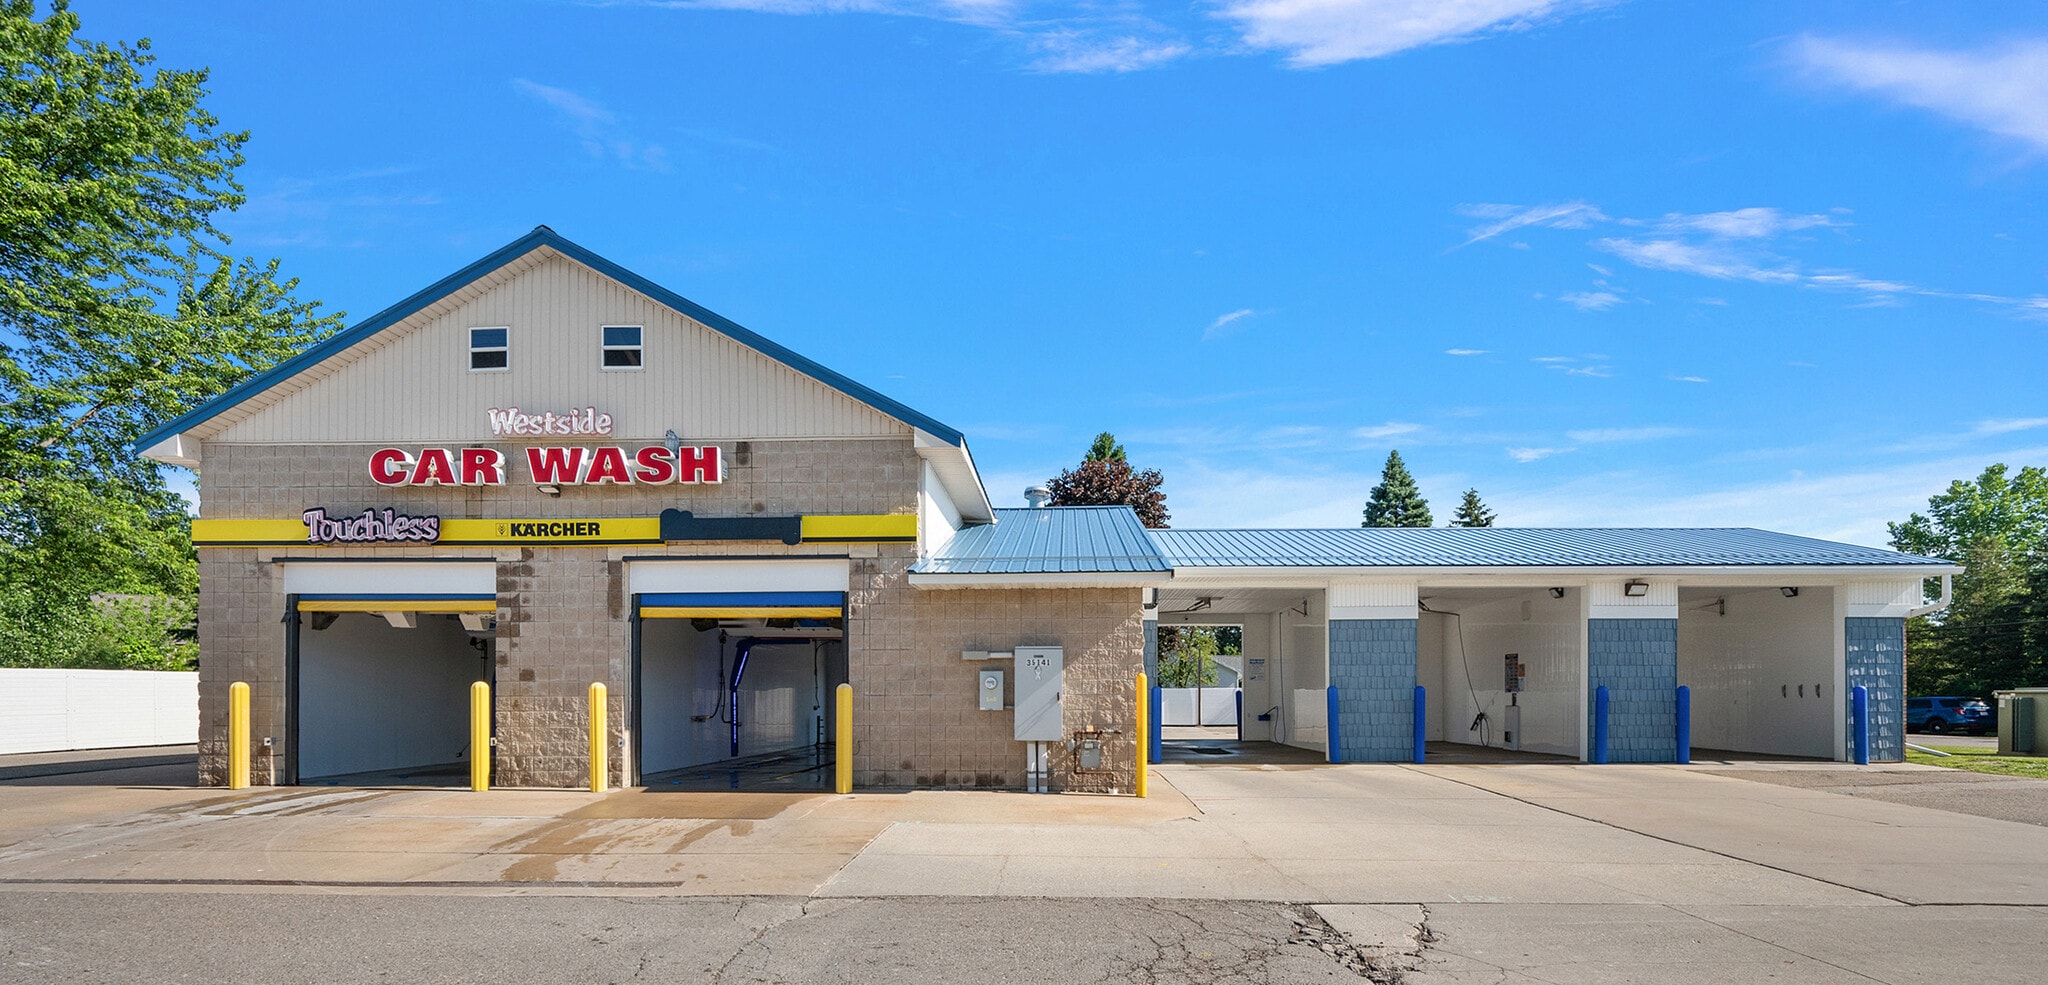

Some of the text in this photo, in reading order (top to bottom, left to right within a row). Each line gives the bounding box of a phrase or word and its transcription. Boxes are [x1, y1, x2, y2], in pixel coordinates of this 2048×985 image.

[488, 407, 613, 436] Westside
[369, 446, 721, 485] CAR WASH
[303, 507, 441, 543] Touchless
[510, 522, 601, 537] KÄRCHER
